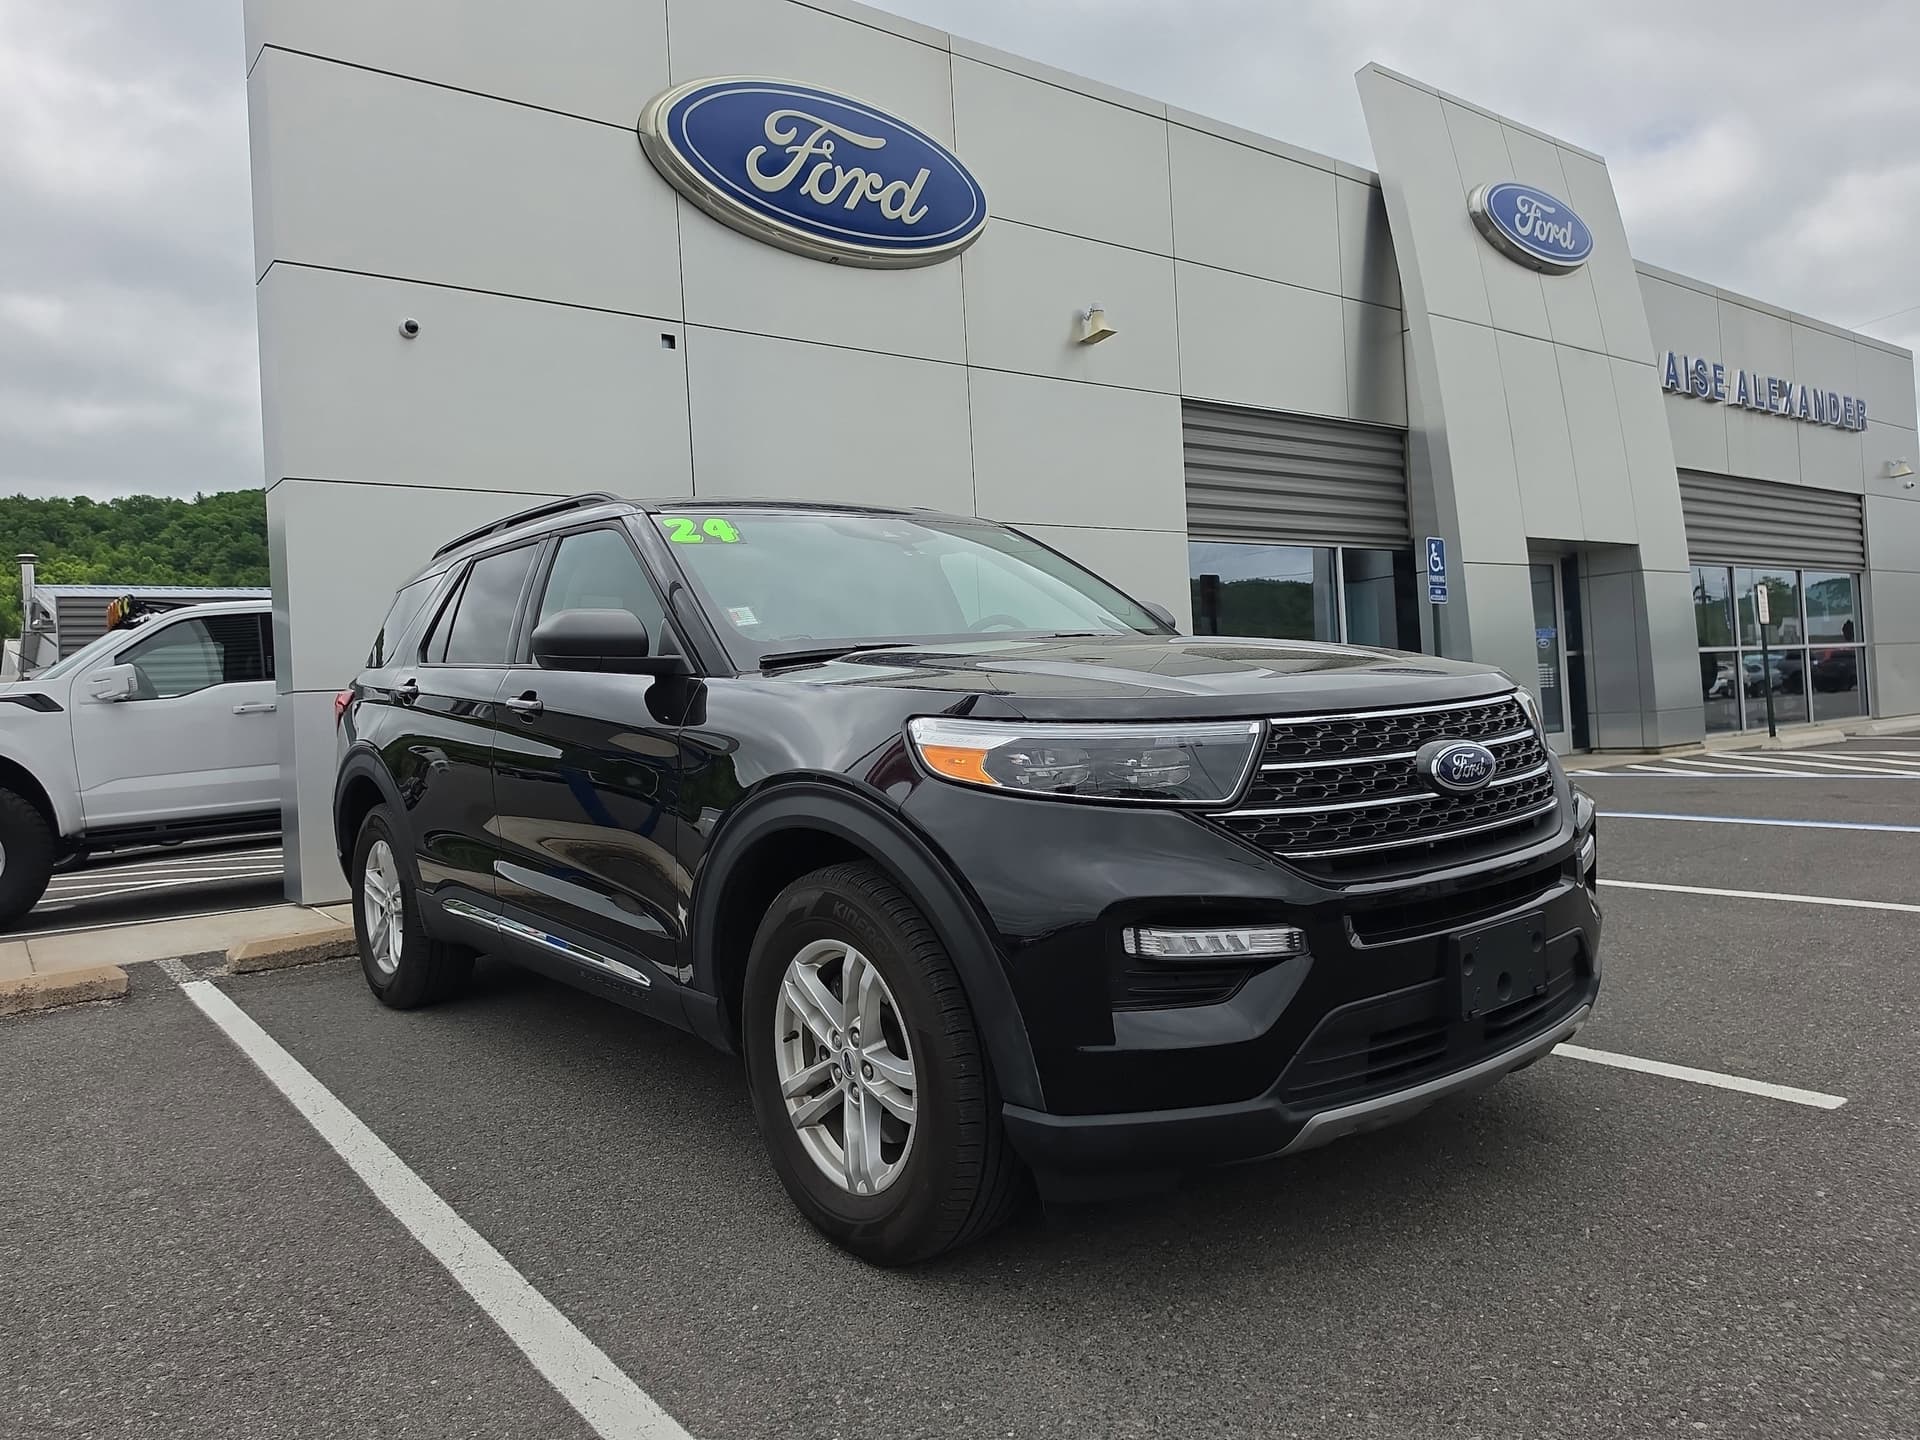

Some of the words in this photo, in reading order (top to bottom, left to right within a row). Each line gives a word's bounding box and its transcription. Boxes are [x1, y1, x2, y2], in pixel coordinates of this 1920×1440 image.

[745, 109, 931, 225] Ford
[1514, 195, 1576, 250] Ford
[1662, 351, 1726, 400] AISE
[1729, 369, 1868, 432] ALEXANDER
[662, 517, 741, 544] 24
[1451, 752, 1487, 780] Ford
